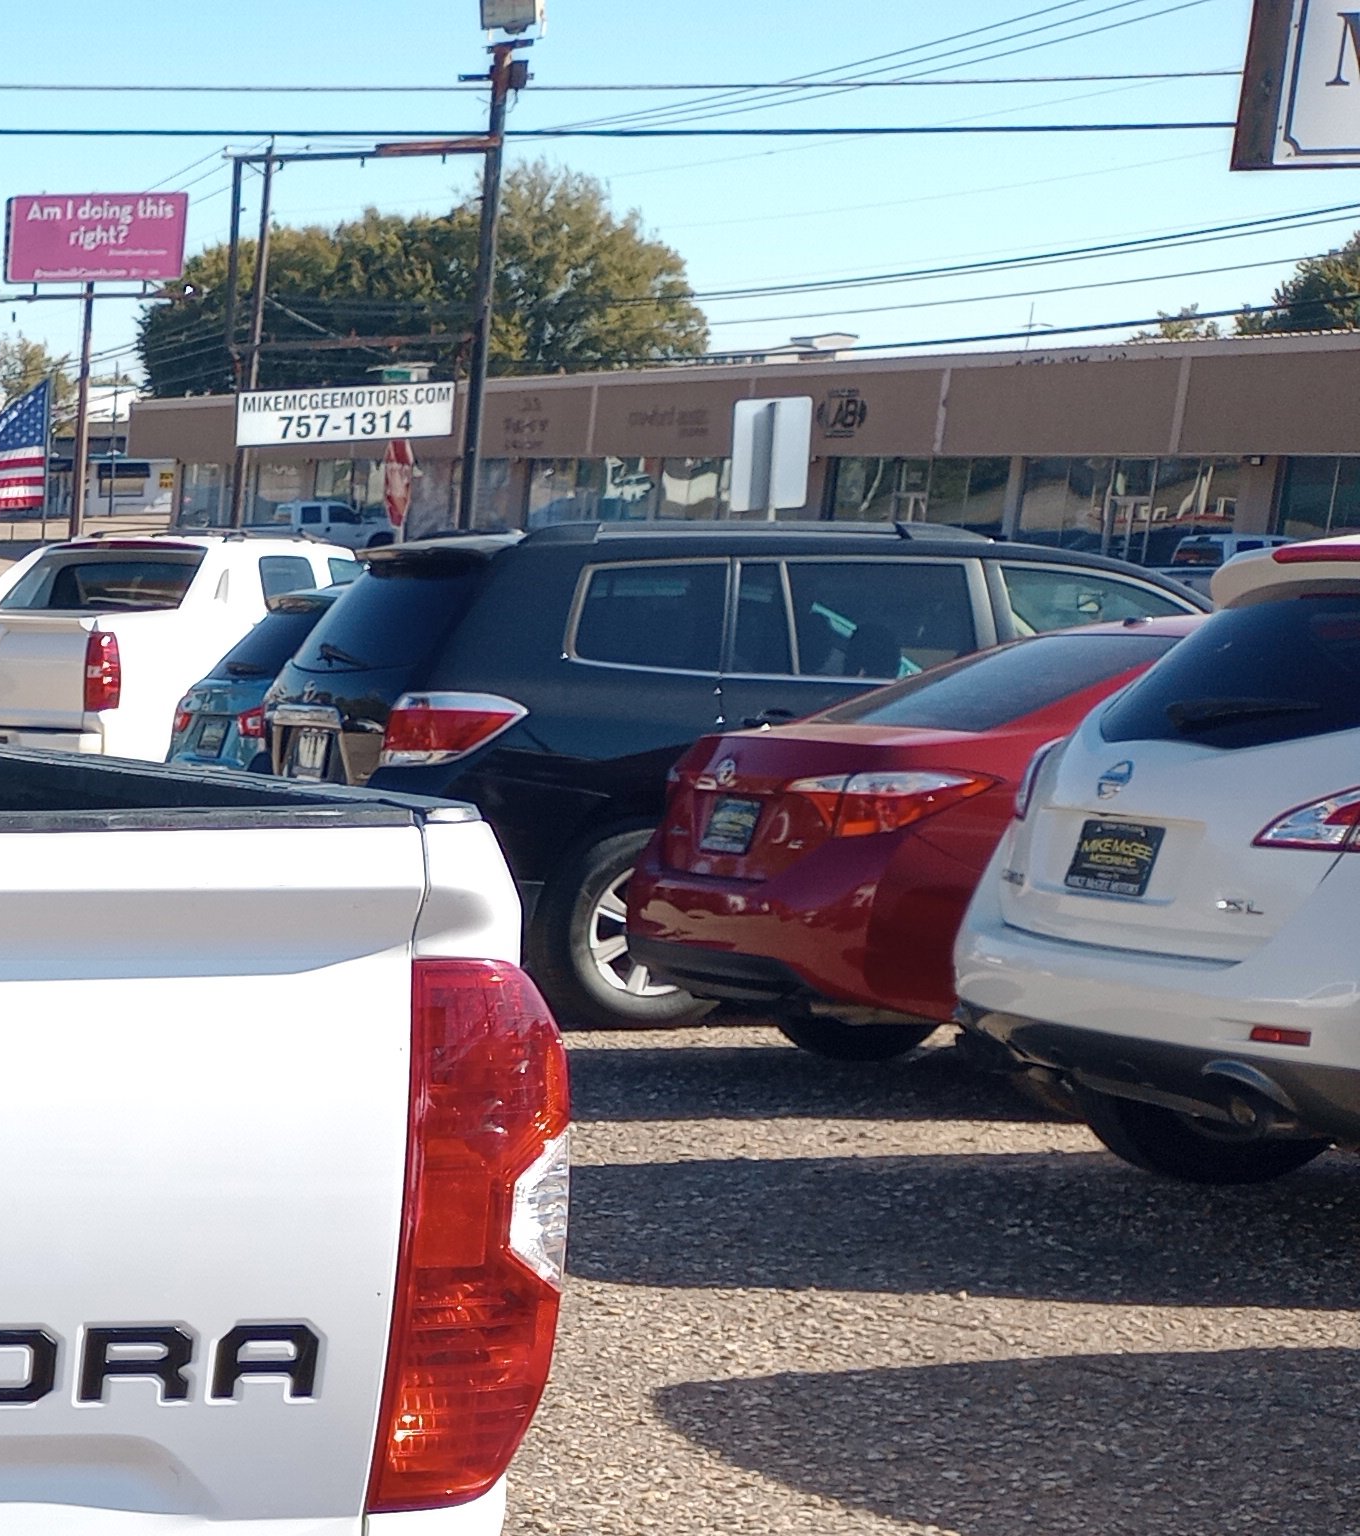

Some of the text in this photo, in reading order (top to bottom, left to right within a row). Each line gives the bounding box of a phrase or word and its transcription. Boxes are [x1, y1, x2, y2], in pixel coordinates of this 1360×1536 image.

[27, 198, 175, 224] Am I doing this
[69, 225, 129, 250] right?
[242, 386, 451, 413] MIKEMCGEEMOTORS.COM
[279, 410, 412, 439] 757-1314
[1081, 838, 1113, 854] MIKE
